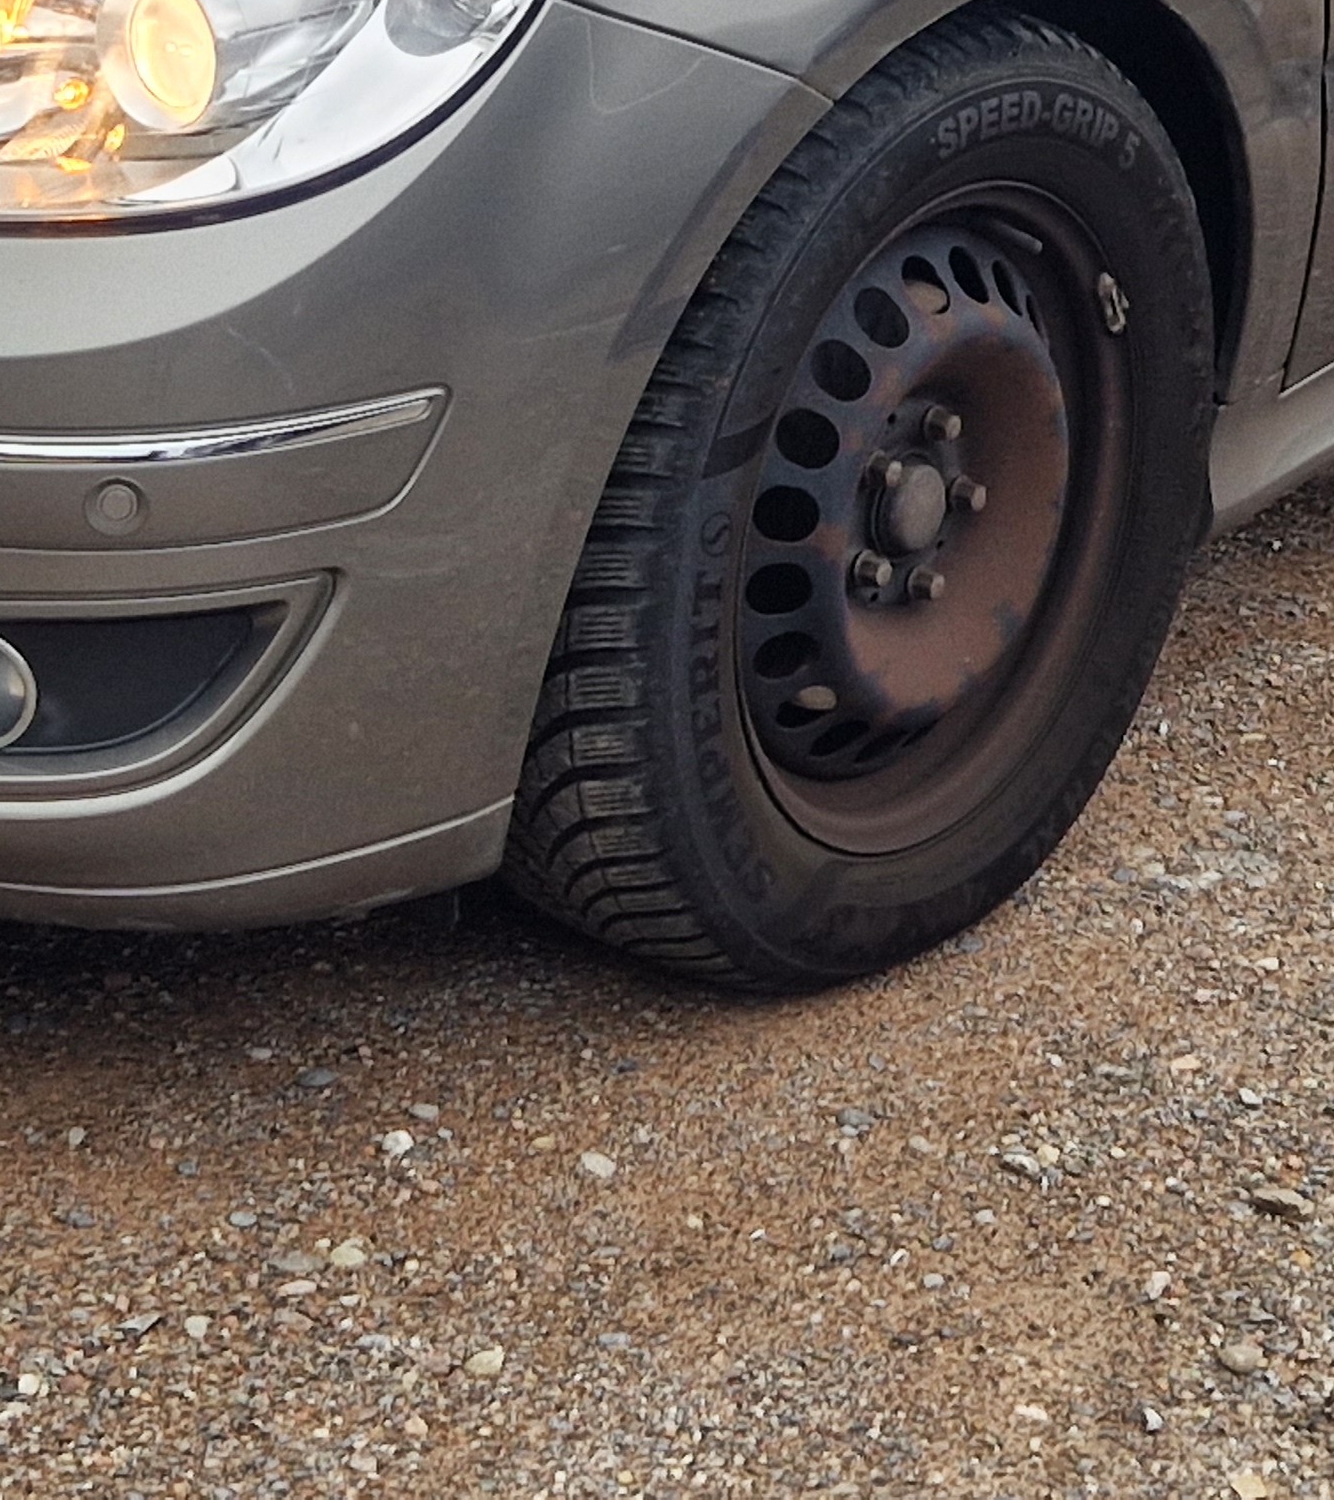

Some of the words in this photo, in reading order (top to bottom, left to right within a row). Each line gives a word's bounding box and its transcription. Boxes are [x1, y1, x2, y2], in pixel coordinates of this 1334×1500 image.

[937, 90, 1119, 159] SPEED-GRIP
[1120, 132, 1141, 169] 5
[689, 571, 776, 904] SEMPERIT
